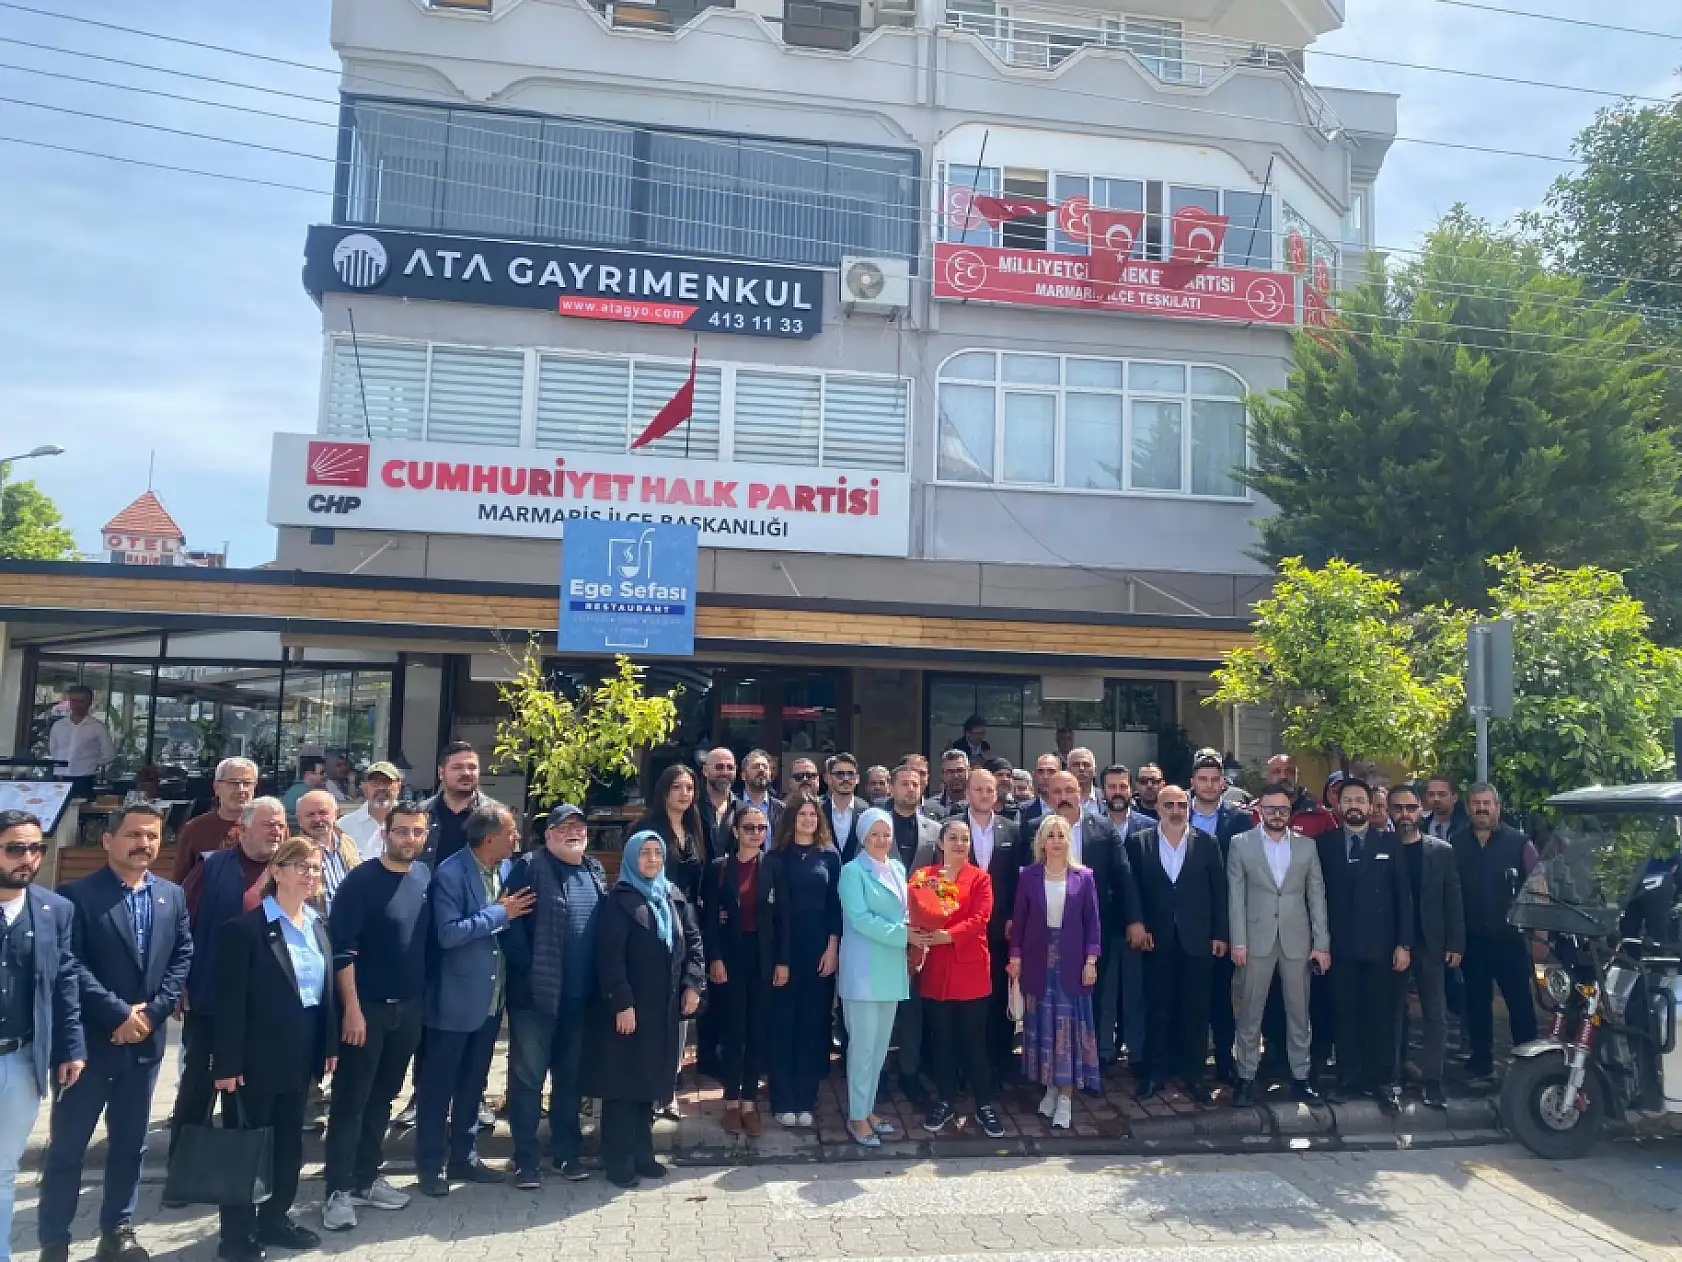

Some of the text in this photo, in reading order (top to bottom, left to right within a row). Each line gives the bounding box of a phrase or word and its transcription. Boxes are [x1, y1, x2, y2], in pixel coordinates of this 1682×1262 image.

[403, 248, 493, 283] ATA
[562, 300, 685, 319] www.atagyo.com
[708, 311, 804, 334] 413 11 33
[381, 457, 880, 516] CUMHURİYET HALK PARTİSİ
[308, 494, 362, 514] CHP
[108, 534, 174, 553] OTEL
[569, 578, 687, 600] Ege Sefası
[584, 602, 670, 613] RESTAURANT
